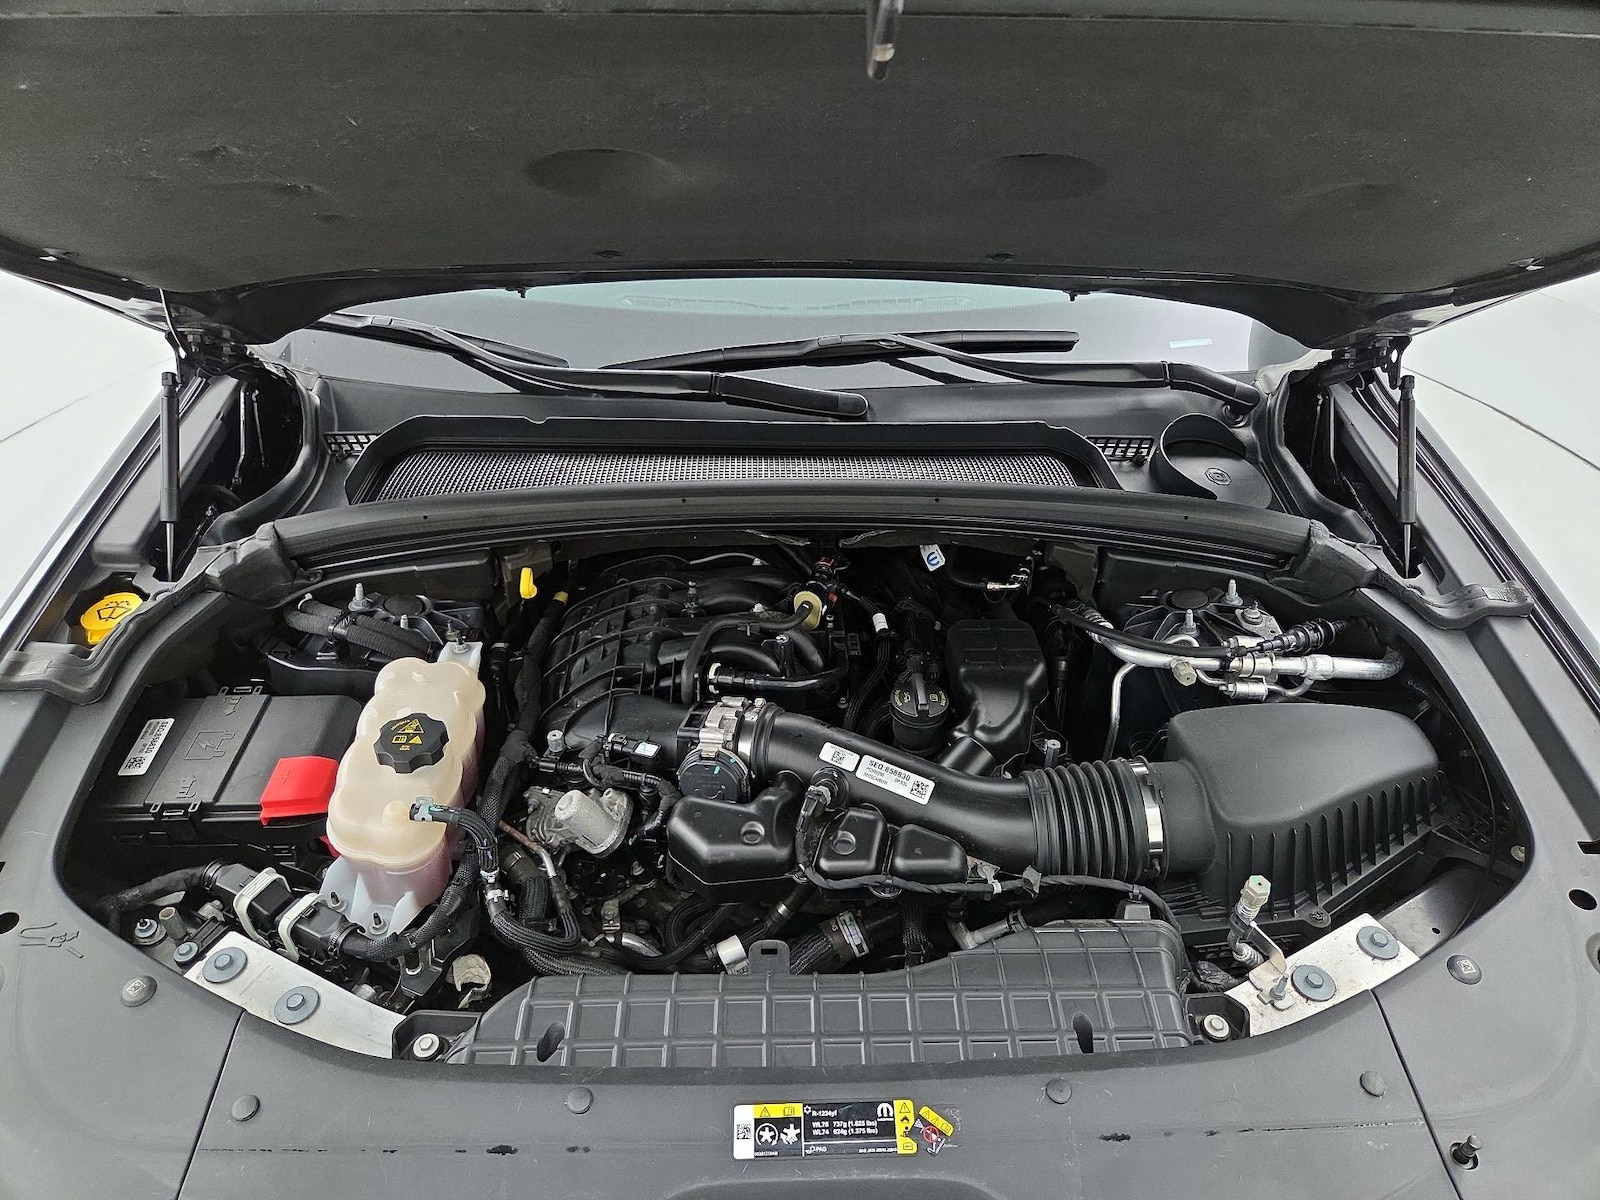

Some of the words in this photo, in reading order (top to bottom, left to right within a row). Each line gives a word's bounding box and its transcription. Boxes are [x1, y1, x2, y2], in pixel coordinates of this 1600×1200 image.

[869, 760, 911, 781] SEQ:858830
[812, 1109, 837, 1118] R-1234yf
[848, 1128, 866, 1136] (1.375
